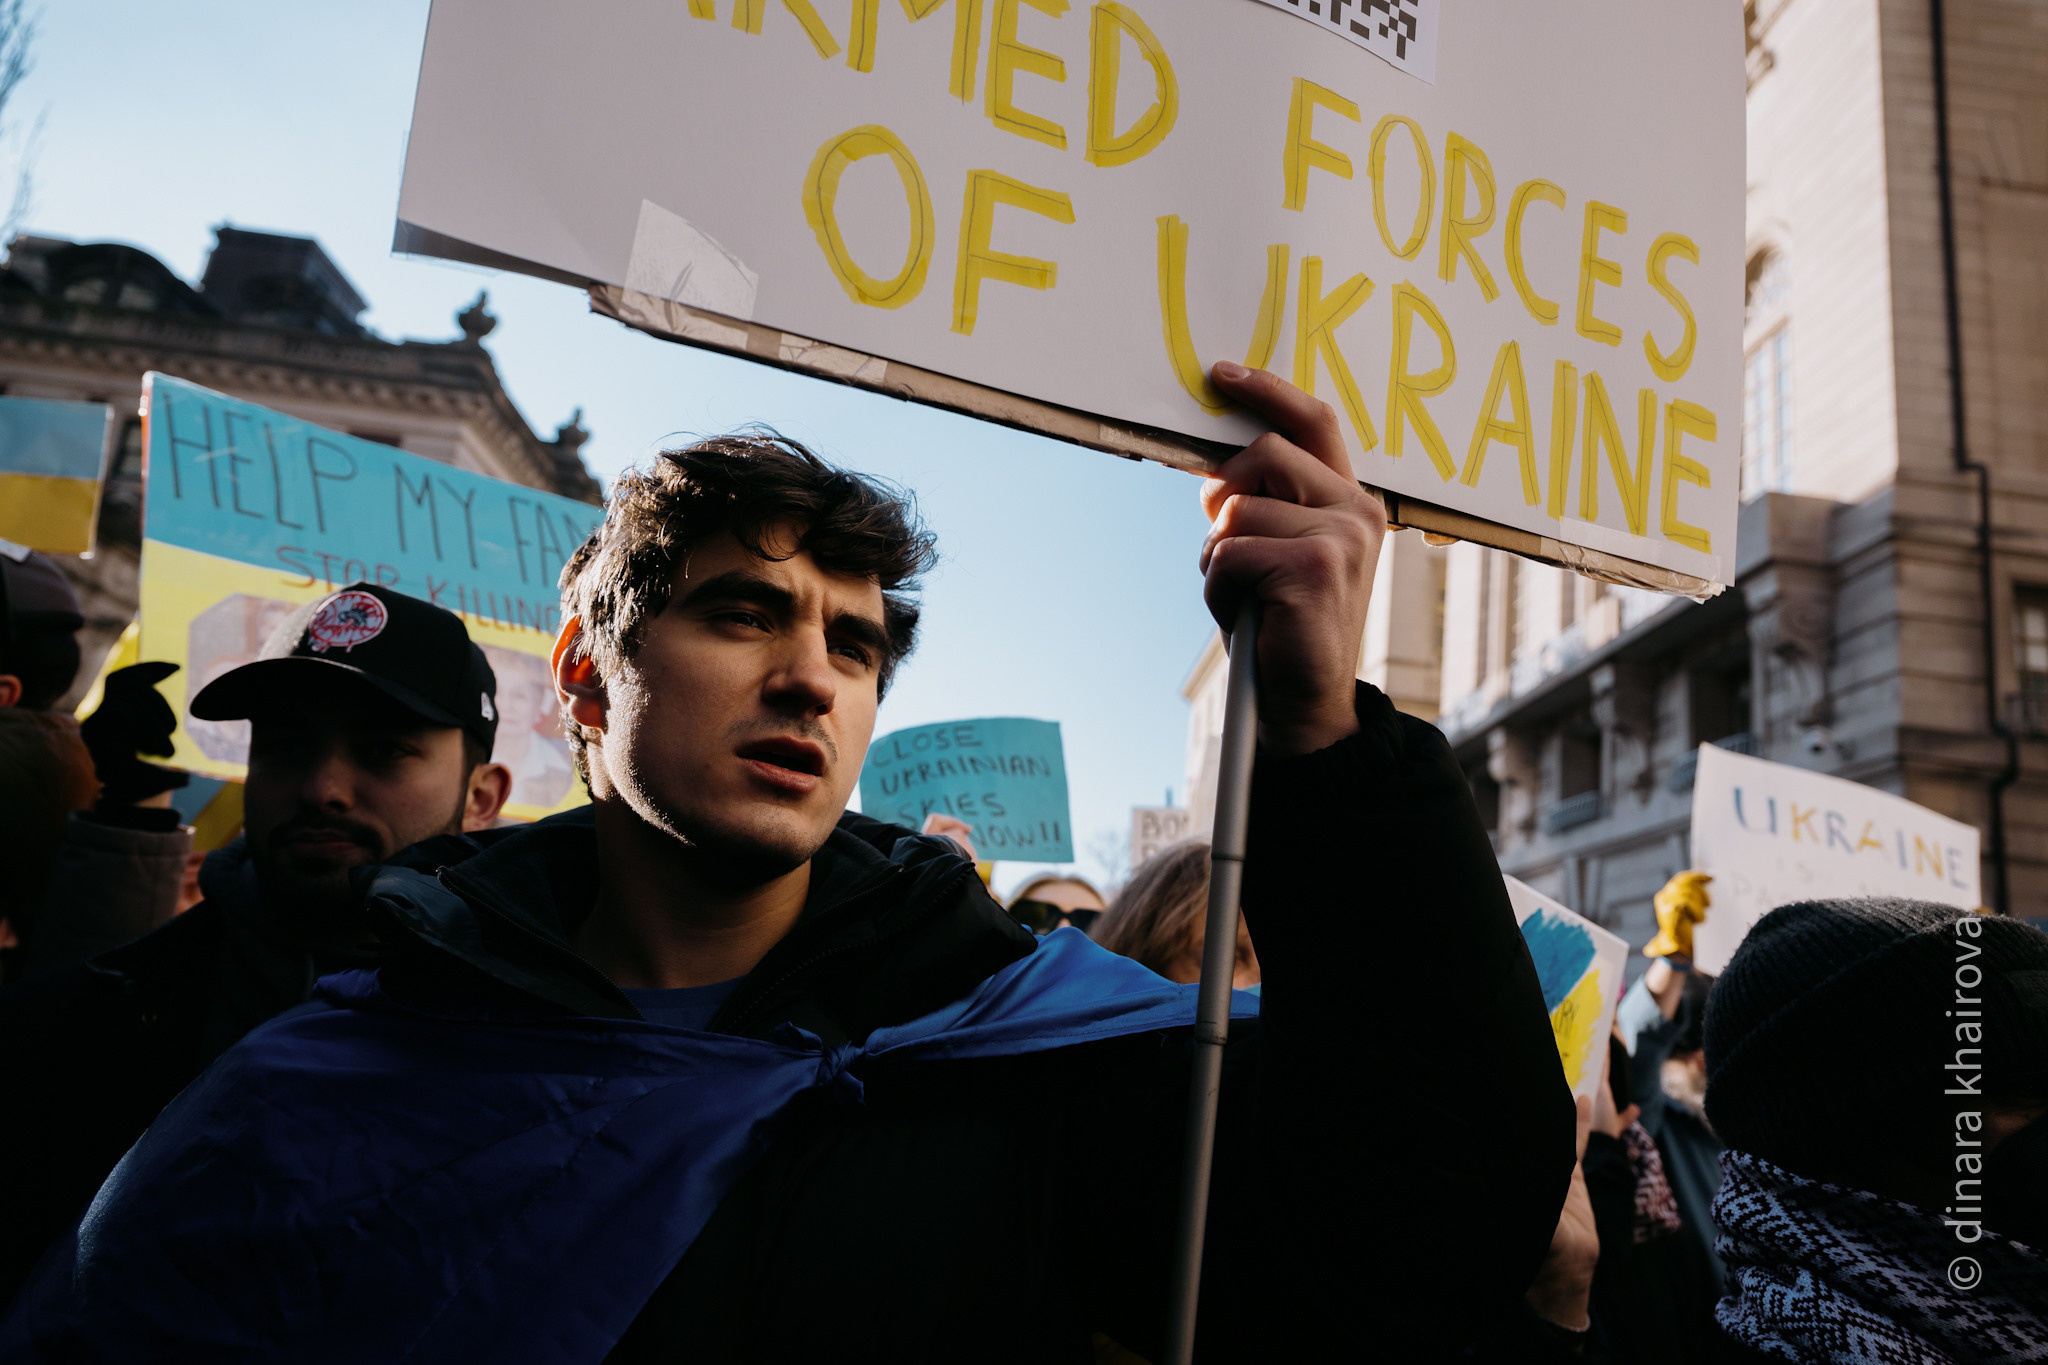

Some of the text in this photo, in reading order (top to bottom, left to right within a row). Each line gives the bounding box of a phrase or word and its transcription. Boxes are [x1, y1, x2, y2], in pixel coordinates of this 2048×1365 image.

[687, 0, 1700, 382] MED FORCES
[802, 124, 1718, 555] OF UKRAINE
[163, 392, 358, 533] HELP
[394, 463, 478, 570] MY
[275, 545, 399, 592] STOP
[872, 725, 983, 768] CLOSE
[880, 753, 1051, 796] UKRAINIAN
[897, 792, 1006, 831] SKIES
[1734, 786, 1970, 890] UKRAINE
